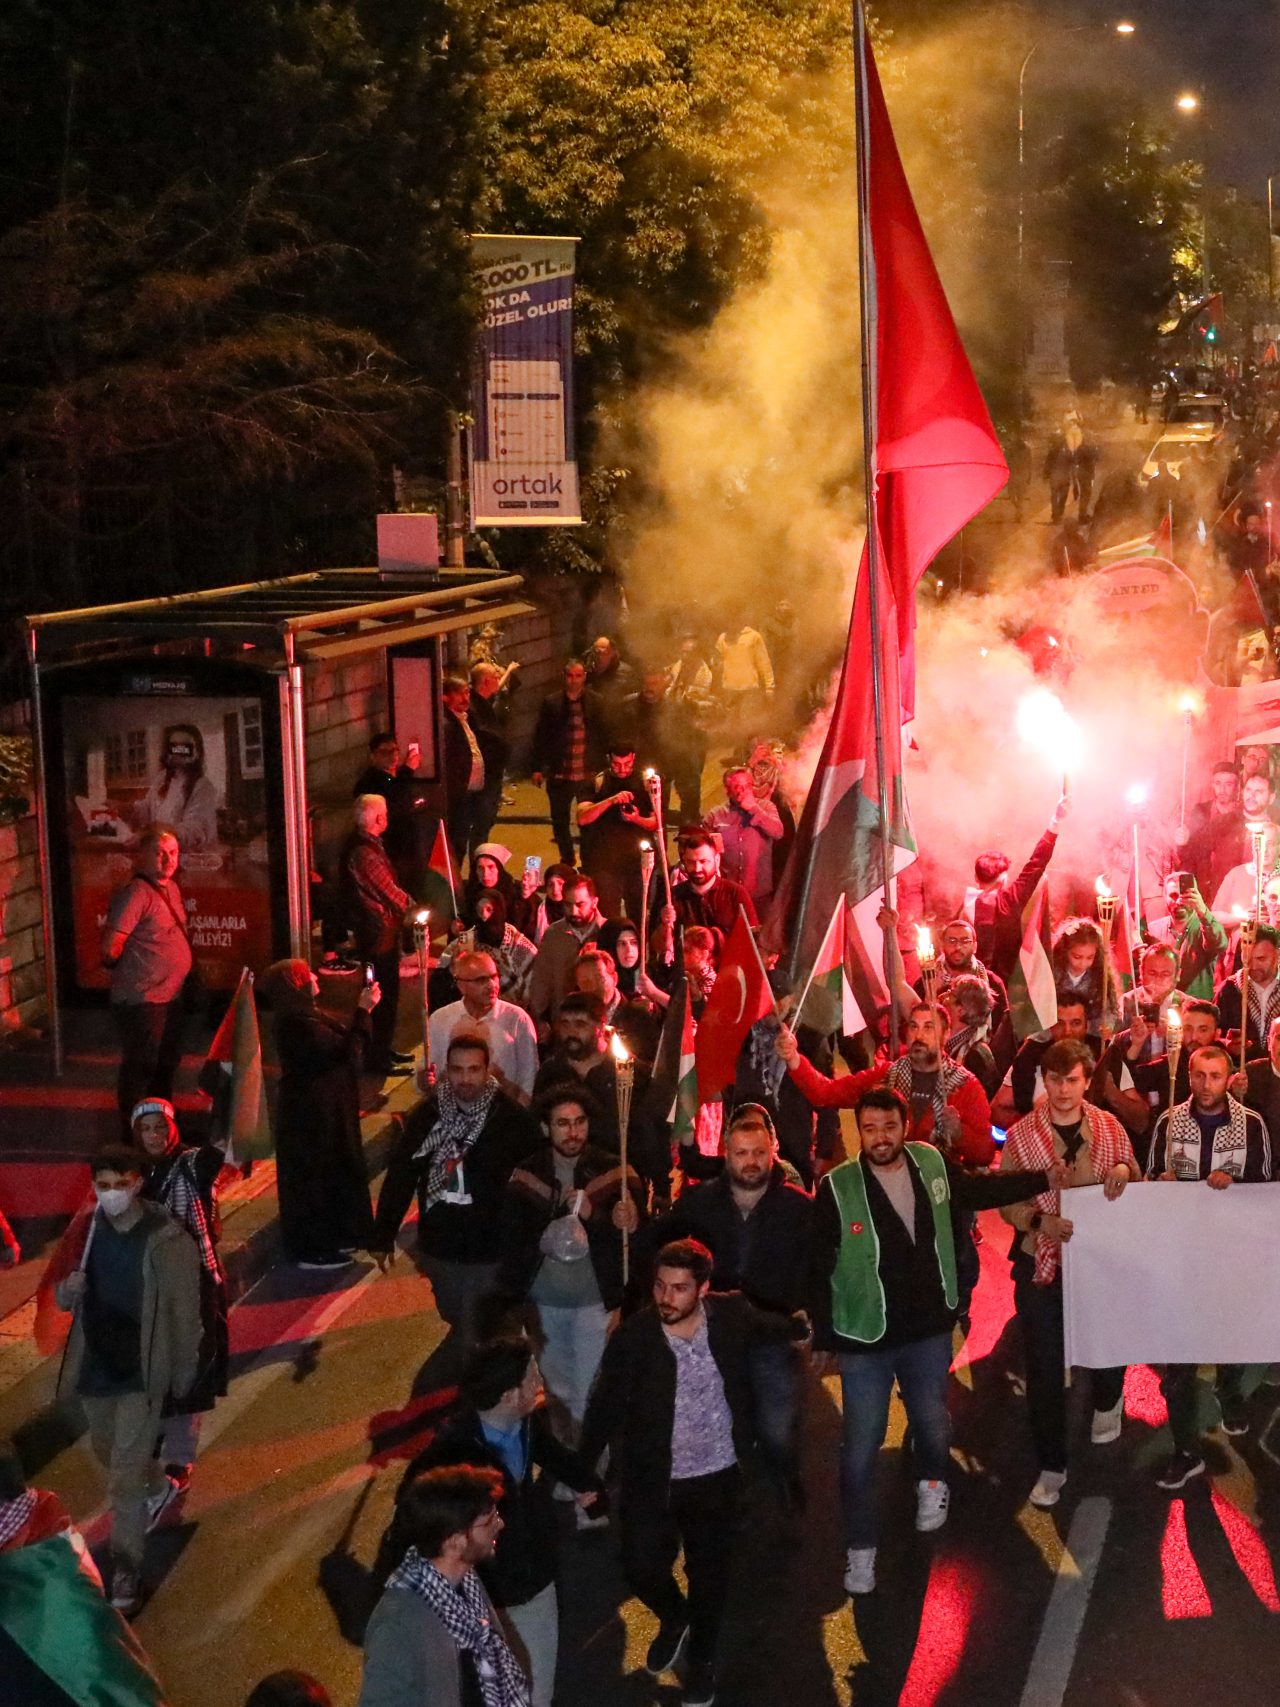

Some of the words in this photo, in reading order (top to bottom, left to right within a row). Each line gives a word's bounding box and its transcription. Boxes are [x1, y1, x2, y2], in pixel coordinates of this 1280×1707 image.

[530, 258, 557, 277] TL
[484, 295, 506, 311] OK
[509, 290, 531, 306] DA
[485, 310, 524, 328] ÜZEL
[526, 297, 573, 318] OLUR!
[493, 472, 563, 495] ortak
[189, 915, 247, 934] AŞANLARLA
